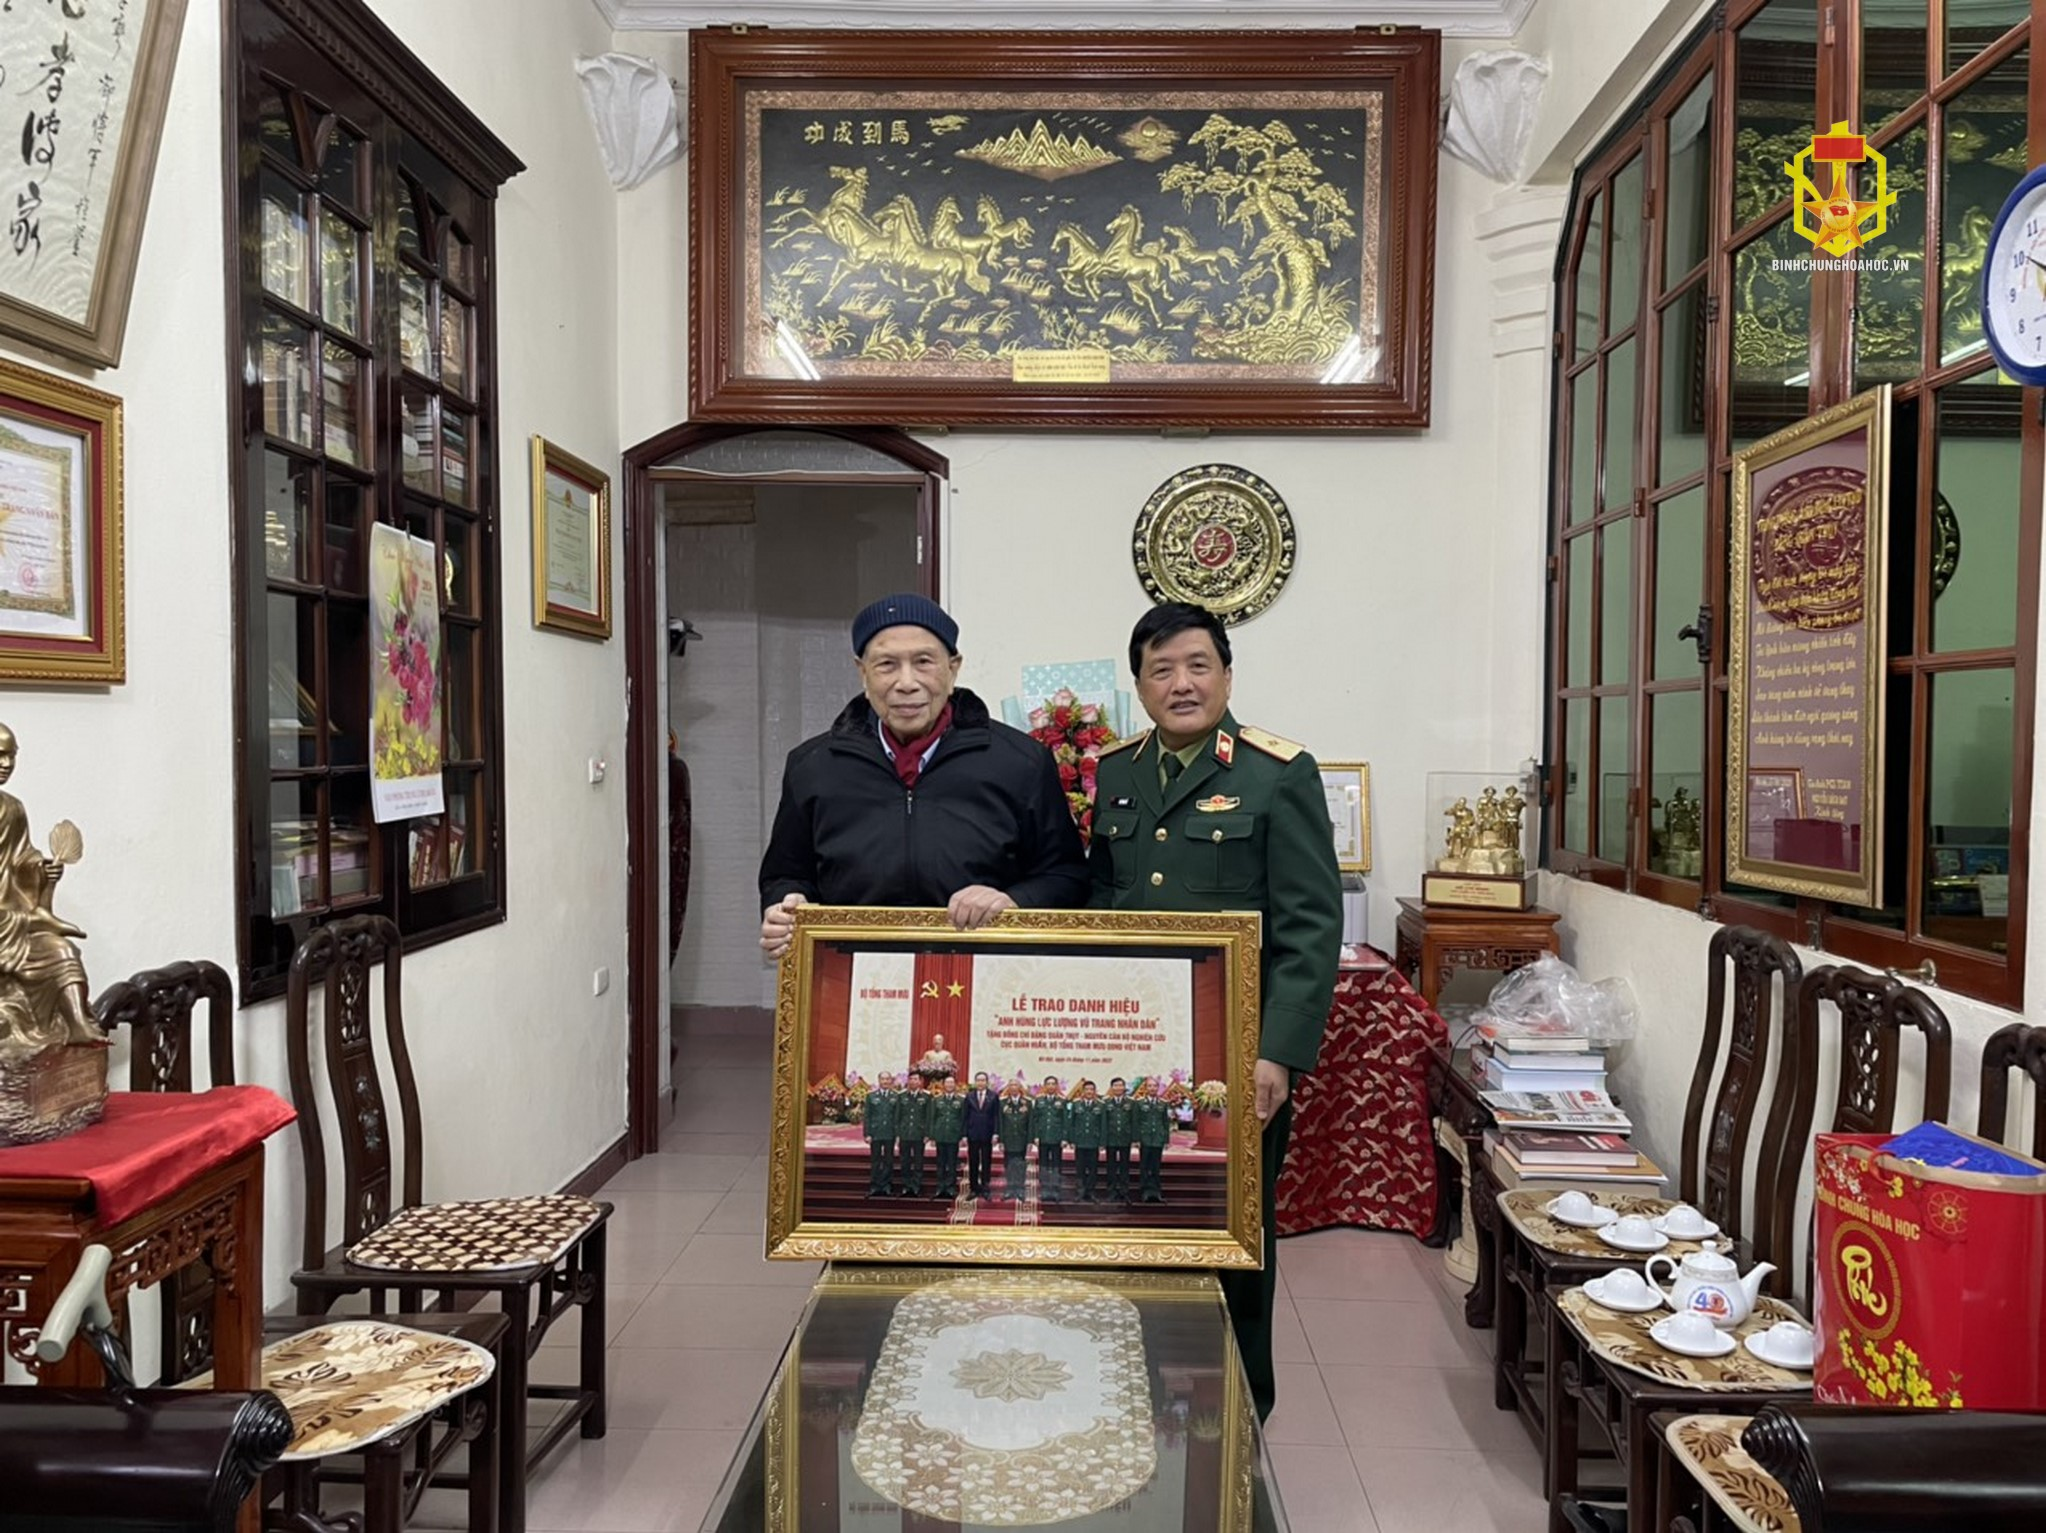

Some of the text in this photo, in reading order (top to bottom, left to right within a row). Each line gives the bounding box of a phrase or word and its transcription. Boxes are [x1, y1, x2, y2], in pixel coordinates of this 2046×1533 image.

[2027, 219, 2039, 237] 11
[2014, 251, 2025, 268] 10
[2010, 288, 2016, 303] 9
[2018, 318, 2025, 334] 8
[2035, 335, 2042, 351] 7
[1012, 993, 1140, 1017] LỄ TRAO DANH HIỆU
[1015, 1015, 1036, 1028] HÙNG
[1053, 1017, 1078, 1030] LƯỢNG
[1091, 1018, 1115, 1029] TRANG
[1117, 1018, 1139, 1029] NHÂN
[1871, 1208, 1893, 1232] HÓA
[1894, 1217, 1920, 1241] HỌC
